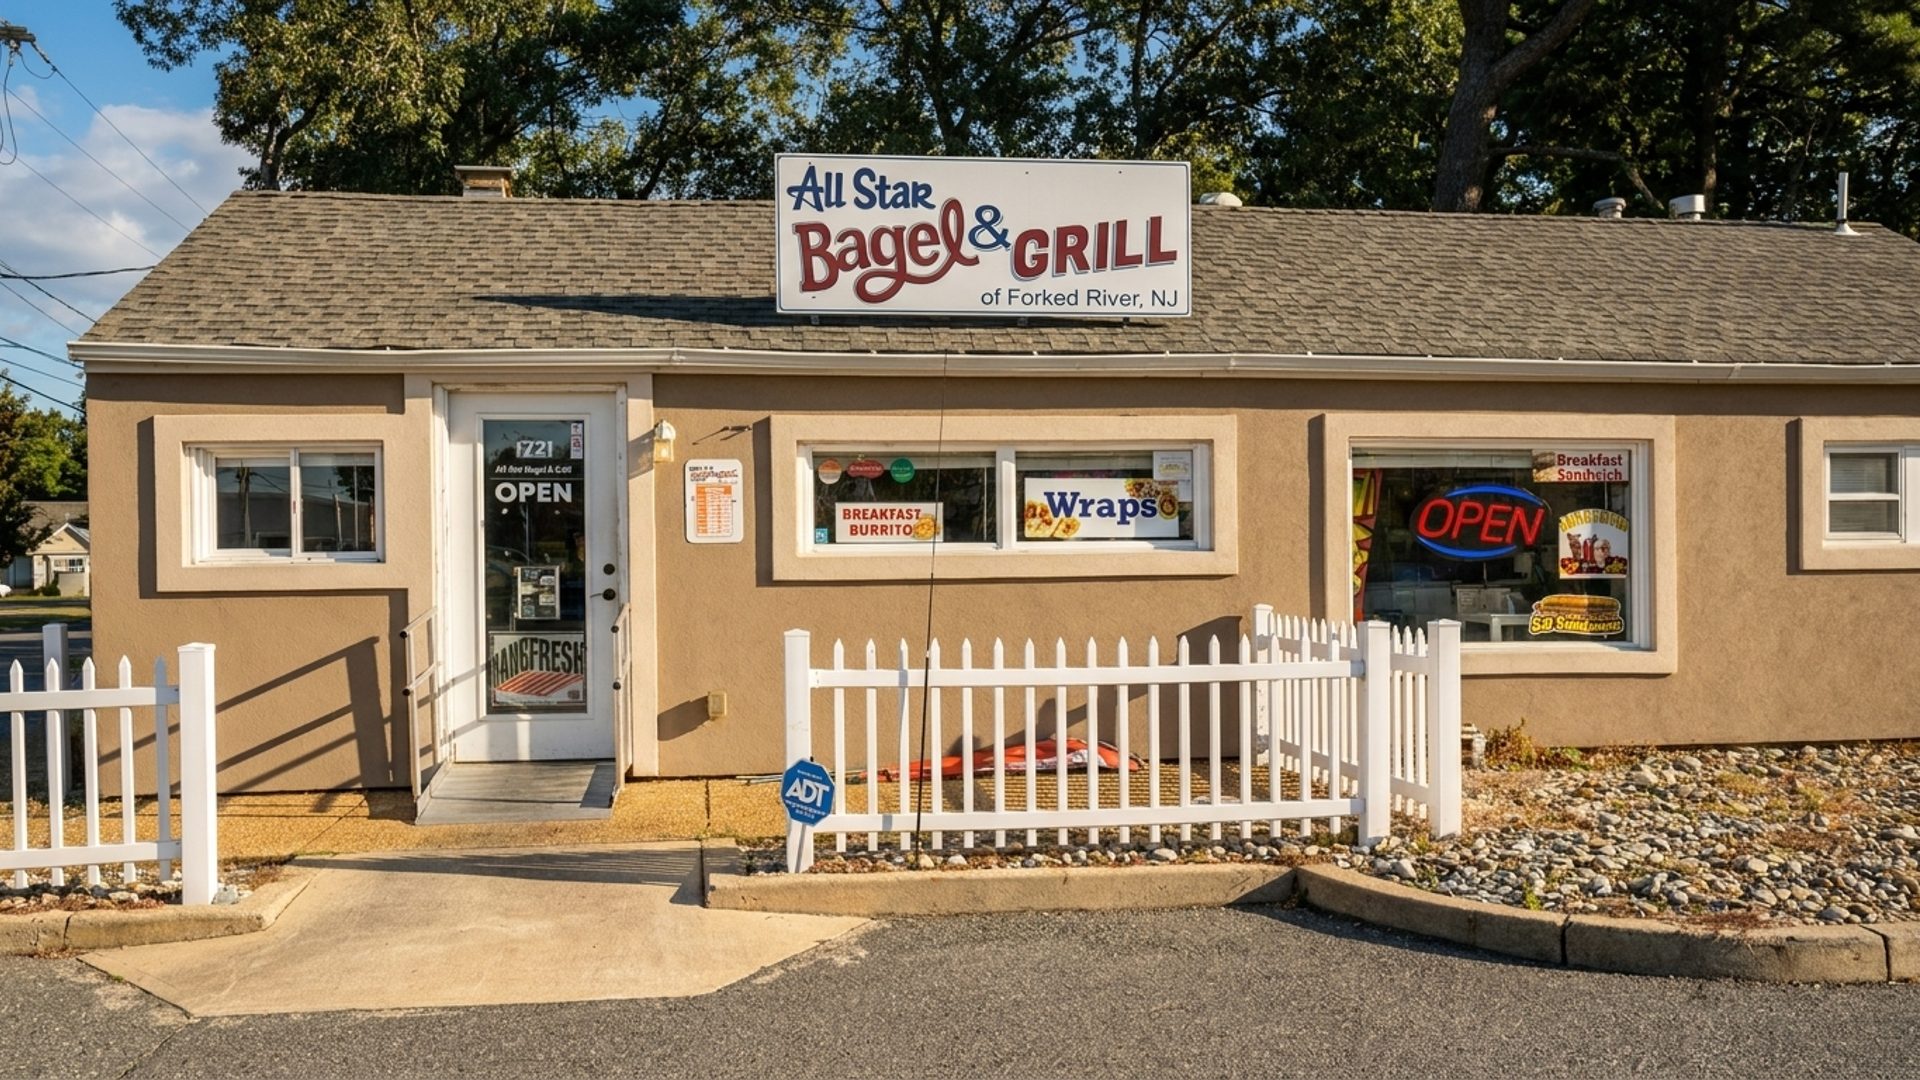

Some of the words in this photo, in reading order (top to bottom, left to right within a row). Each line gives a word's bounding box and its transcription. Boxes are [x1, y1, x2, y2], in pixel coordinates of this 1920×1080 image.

[787, 165, 846, 212] All
[792, 197, 980, 304] Bagel
[968, 205, 1011, 251] &
[1010, 216, 1177, 281] GRILL
[981, 288, 1002, 306] of
[1008, 288, 1079, 306] Forked
[1087, 288, 1143, 308] River,
[1151, 289, 1178, 307] NJ
[1557, 453, 1623, 466] Breakfast
[494, 482, 573, 503] OPEN
[842, 508, 922, 520] BREAKFAST
[1043, 491, 1158, 525] Wraps
[849, 524, 914, 536] BURRITO
[1416, 498, 1545, 546] OPEN
[785, 777, 830, 807] ADT
